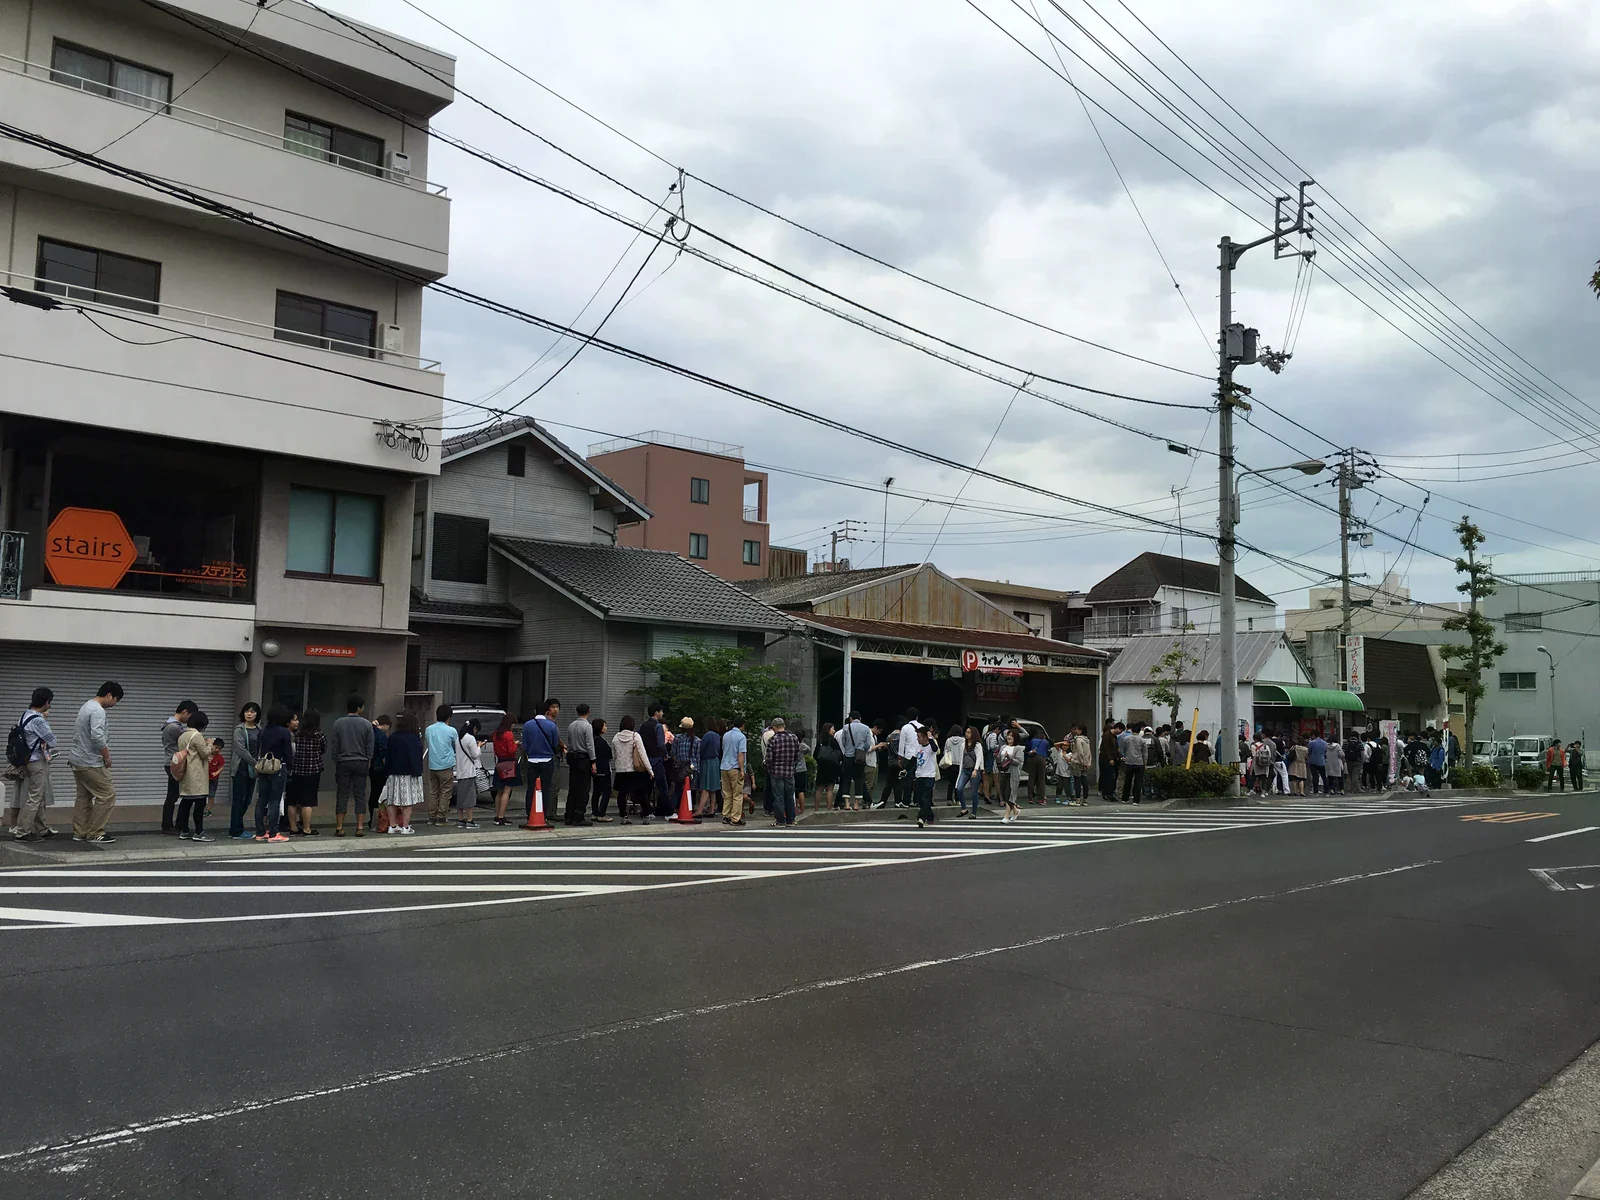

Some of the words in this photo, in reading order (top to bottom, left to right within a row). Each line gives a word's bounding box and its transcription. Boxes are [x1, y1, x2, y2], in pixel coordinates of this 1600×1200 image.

[52, 535, 122, 557] stairs
[201, 565, 247, 579] ステアーズ
[966, 651, 976, 669] P
[981, 652, 1004, 667] うどん
